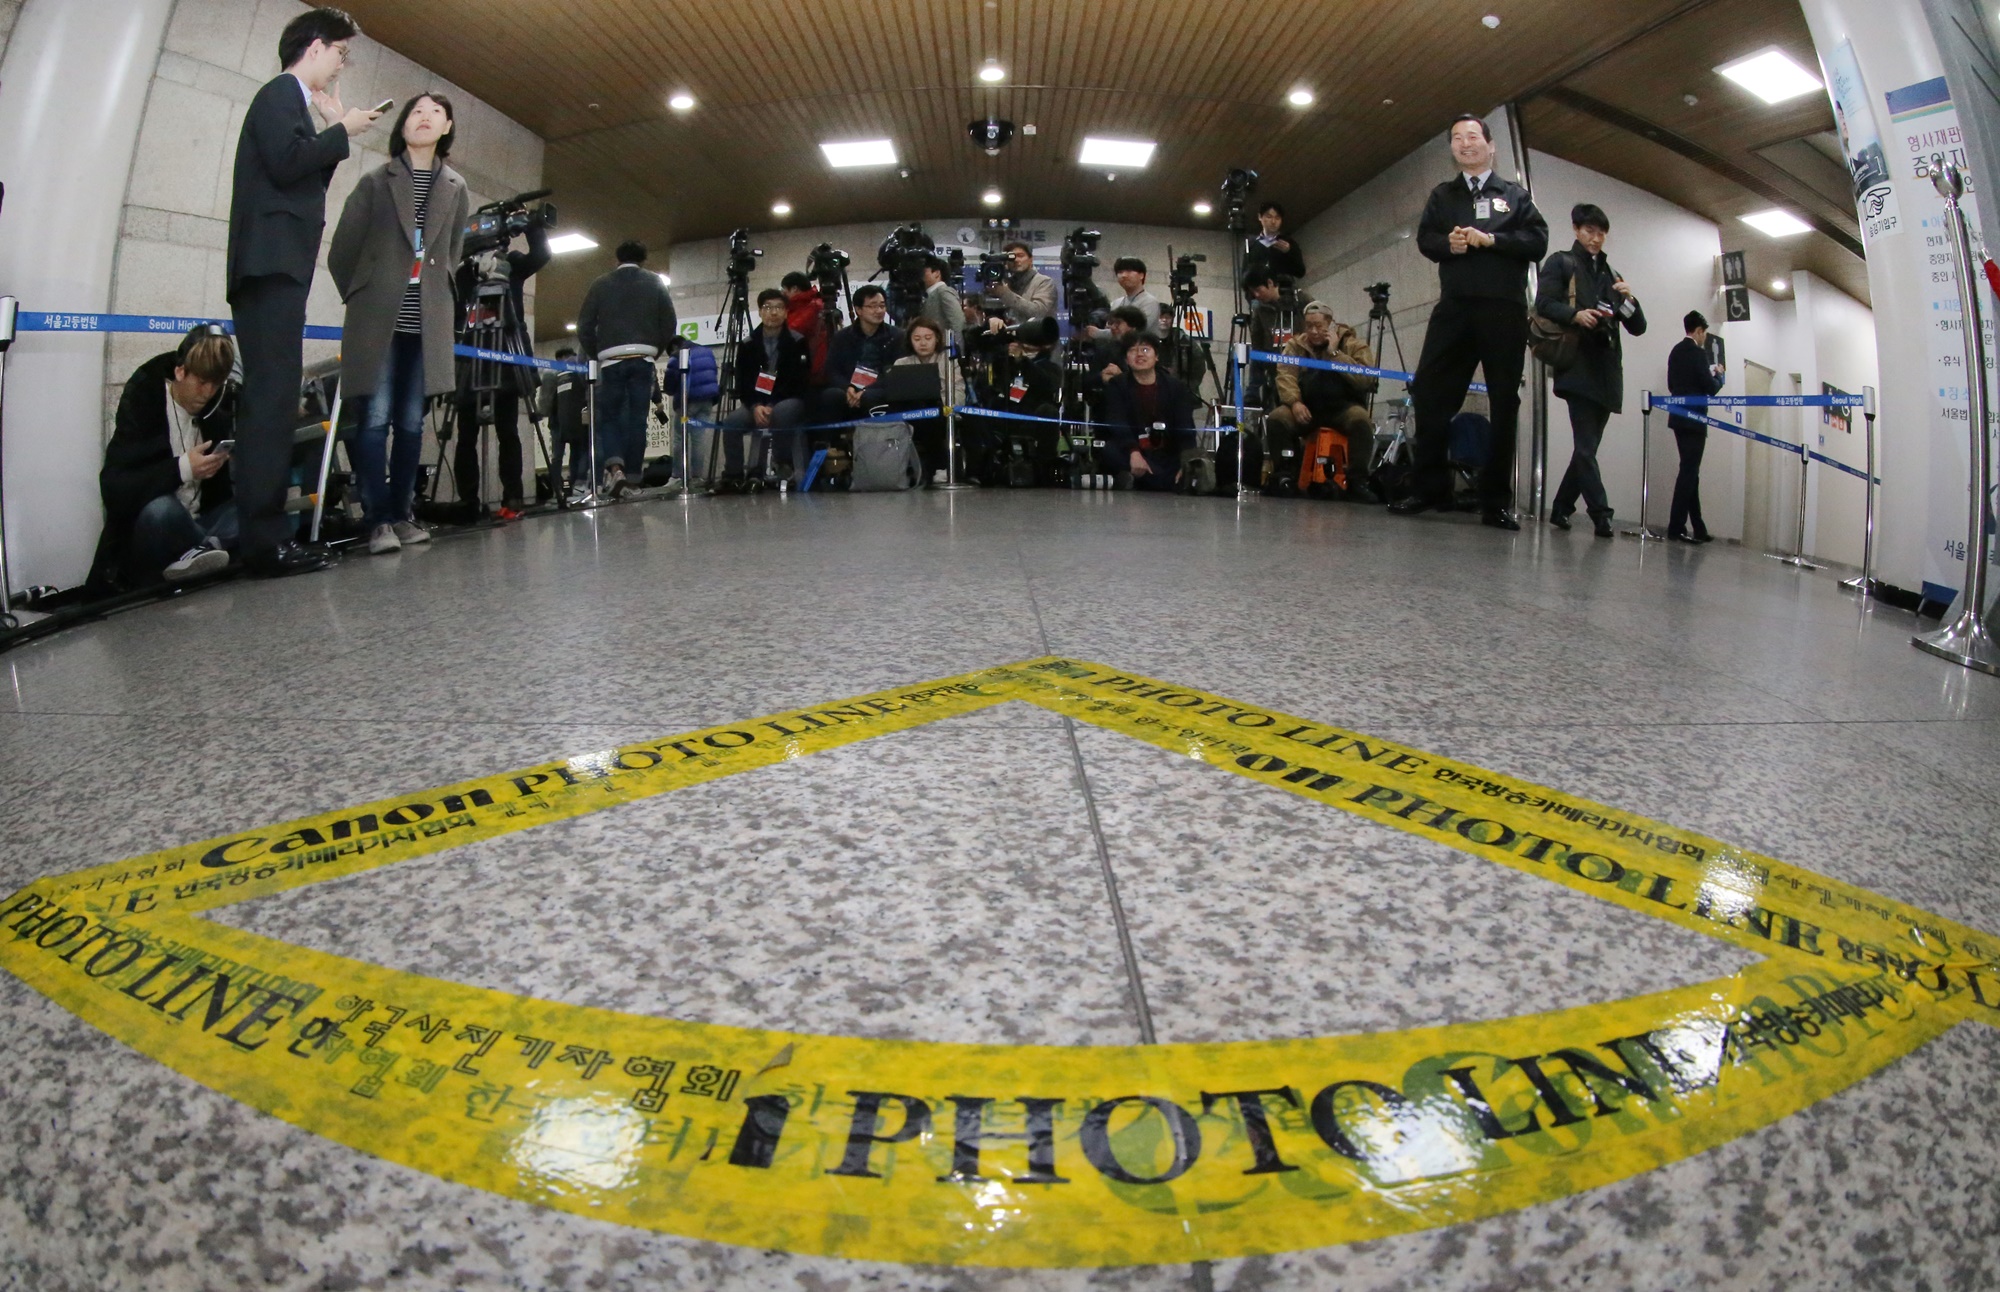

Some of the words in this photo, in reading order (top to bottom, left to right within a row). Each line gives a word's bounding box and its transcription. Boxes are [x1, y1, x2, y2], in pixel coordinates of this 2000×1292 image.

[44, 315, 98, 330] 서울고등법원
[149, 318, 175, 331] Seoul
[1331, 363, 1349, 372] Seoul
[1350, 365, 1364, 374] High
[1365, 366, 1381, 376] Court
[1707, 397, 1720, 405] Seoul
[1832, 396, 1848, 405] Seoul
[1849, 396, 1863, 406] High
[902, 410, 922, 420] Seoul
[759, 698, 908, 737] LINE
[1089, 675, 1275, 727] PHOTO
[1274, 725, 1429, 774] LINE
[200, 788, 495, 869] Canon
[1344, 783, 1625, 884] PHOTO
[0, 892, 145, 978] PHOTO
[119, 953, 306, 1052] LINE
[824, 1080, 1415, 1186] PHOTO
